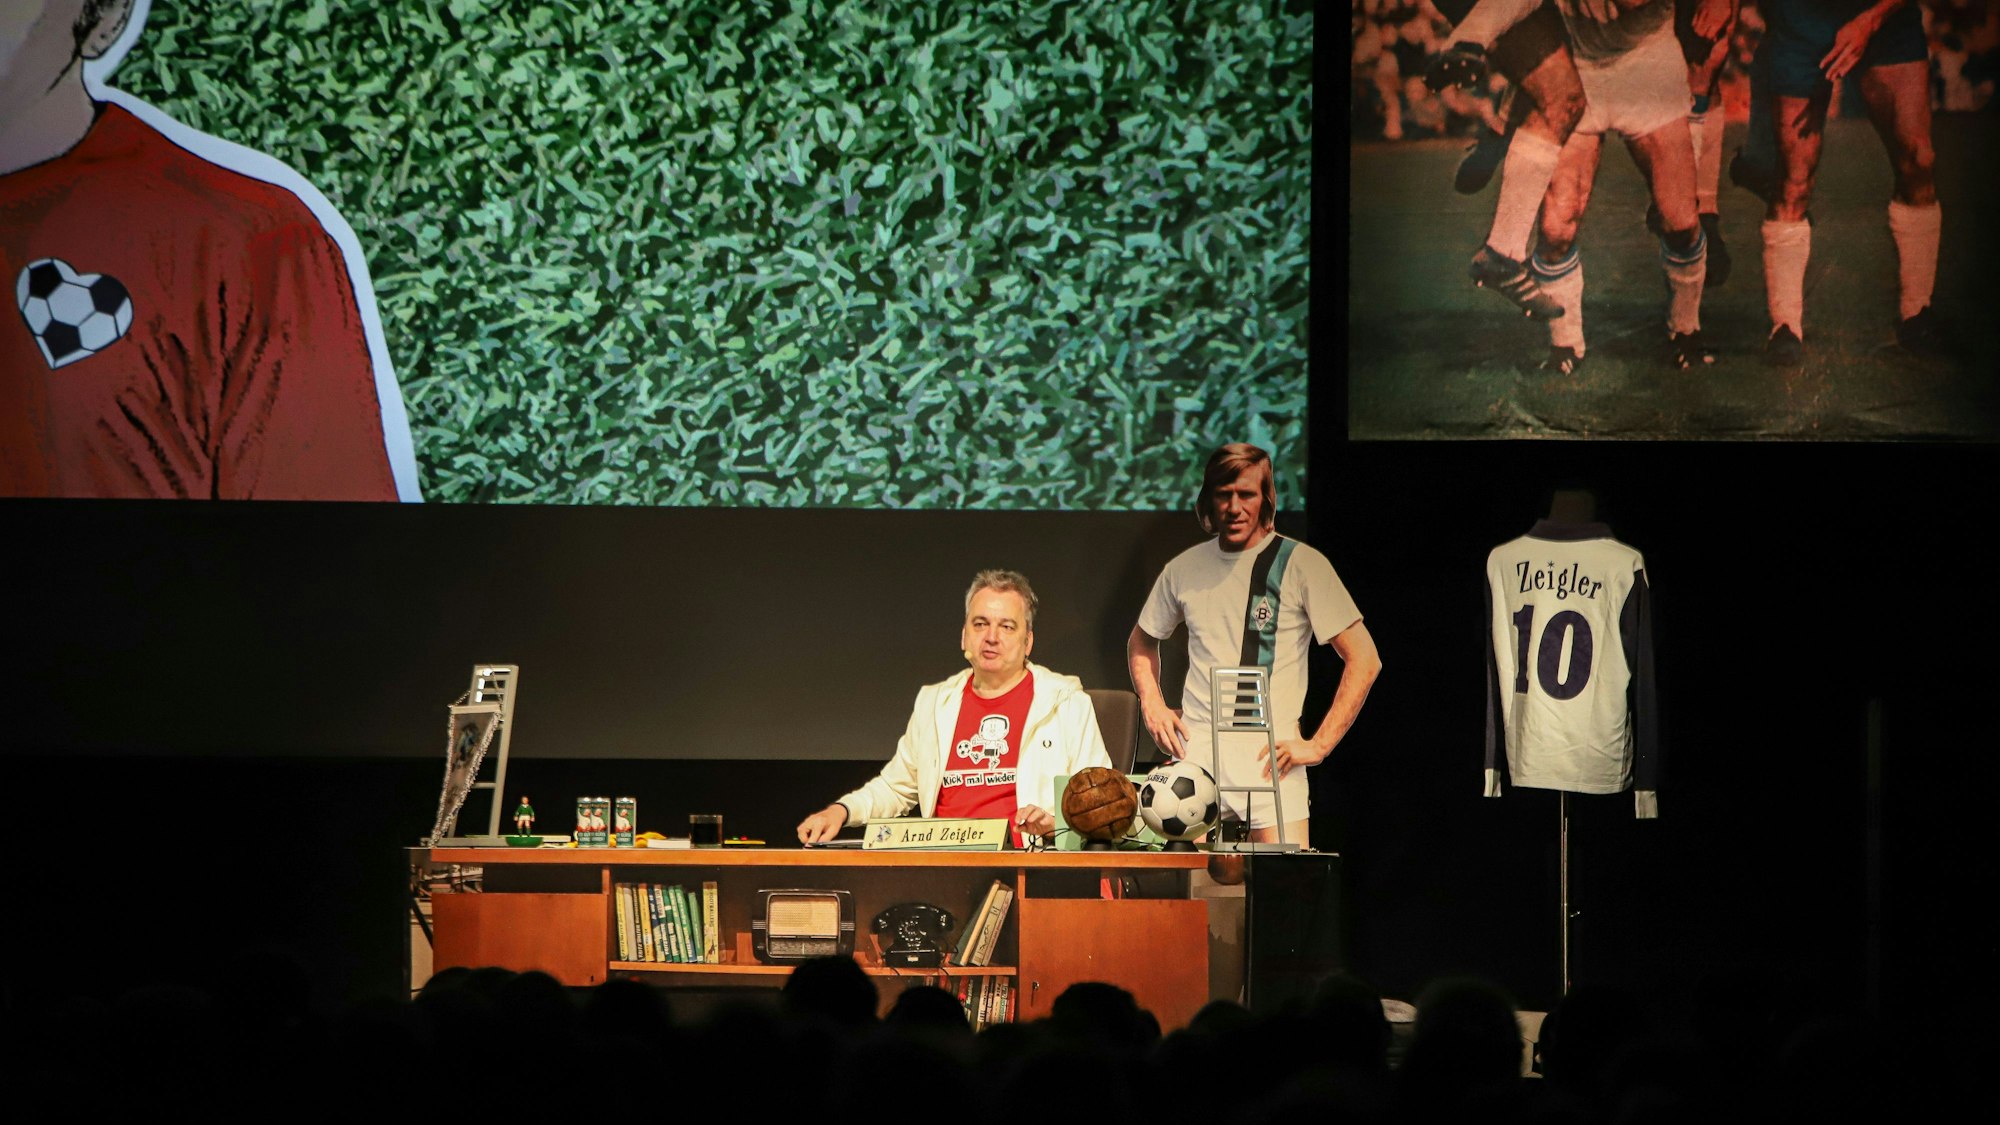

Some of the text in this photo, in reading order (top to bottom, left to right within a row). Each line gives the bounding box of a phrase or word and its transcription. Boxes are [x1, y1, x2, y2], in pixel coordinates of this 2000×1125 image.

[1516, 560, 1602, 600] Zeigler
[1513, 604, 1593, 700] 10
[943, 773, 1016, 786] Kick mal wieder
[901, 827, 984, 843] Arnd Zeigler
